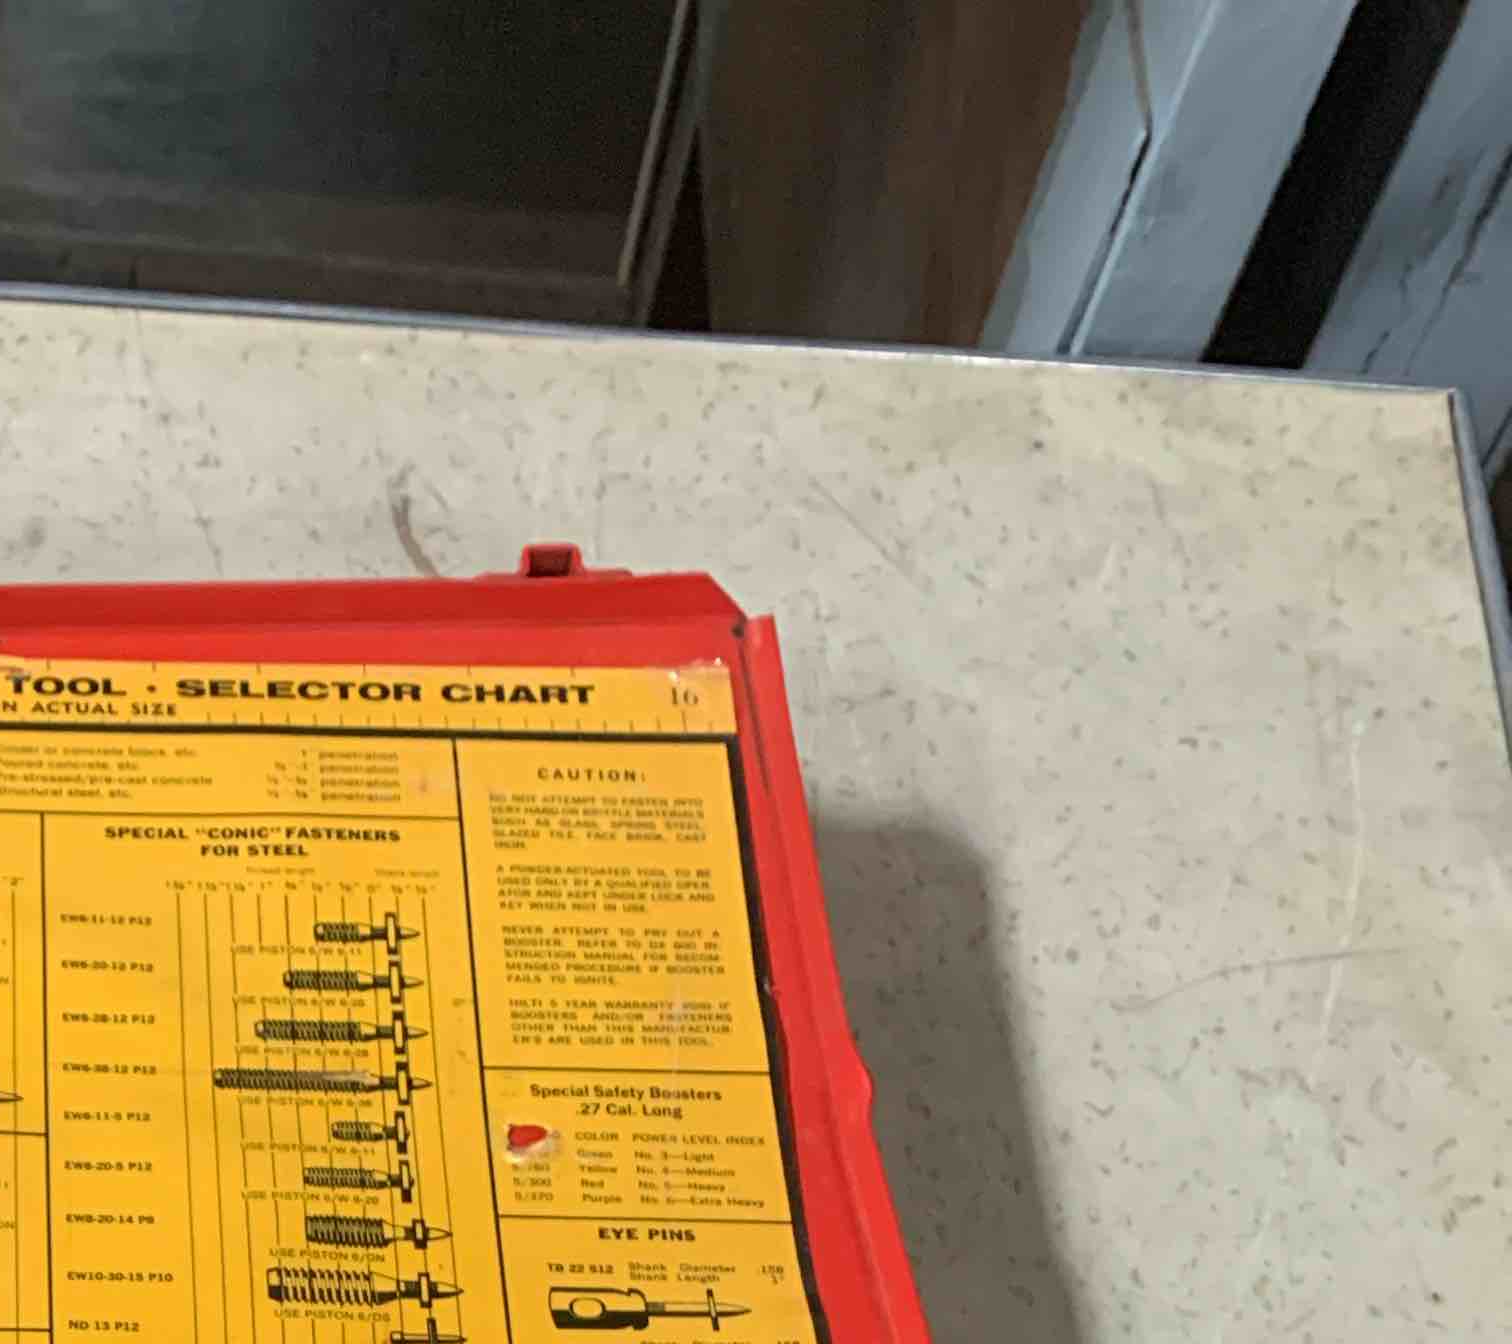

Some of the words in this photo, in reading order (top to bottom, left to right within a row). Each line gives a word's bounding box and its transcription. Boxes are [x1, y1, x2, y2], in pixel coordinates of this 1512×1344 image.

[6, 676, 126, 696] TOOL
[176, 678, 421, 702] SELECTOR
[442, 683, 594, 704] CHART
[32, 701, 118, 715] ACTUAL
[131, 702, 177, 716] SIZE
[538, 768, 647, 782] CAUTION:
[105, 826, 187, 839] SPECIAL
[197, 827, 281, 840] "CONIC"
[286, 827, 400, 842] FASTENERS
[201, 844, 240, 856] FOR
[248, 844, 308, 856] STEEL
[530, 1084, 589, 1099] Special
[594, 1085, 645, 1100] Safety
[650, 1086, 722, 1100] Boosters
[643, 1105, 683, 1119] Long
[599, 1228, 638, 1240] EYE
[648, 1229, 695, 1242] PINS
